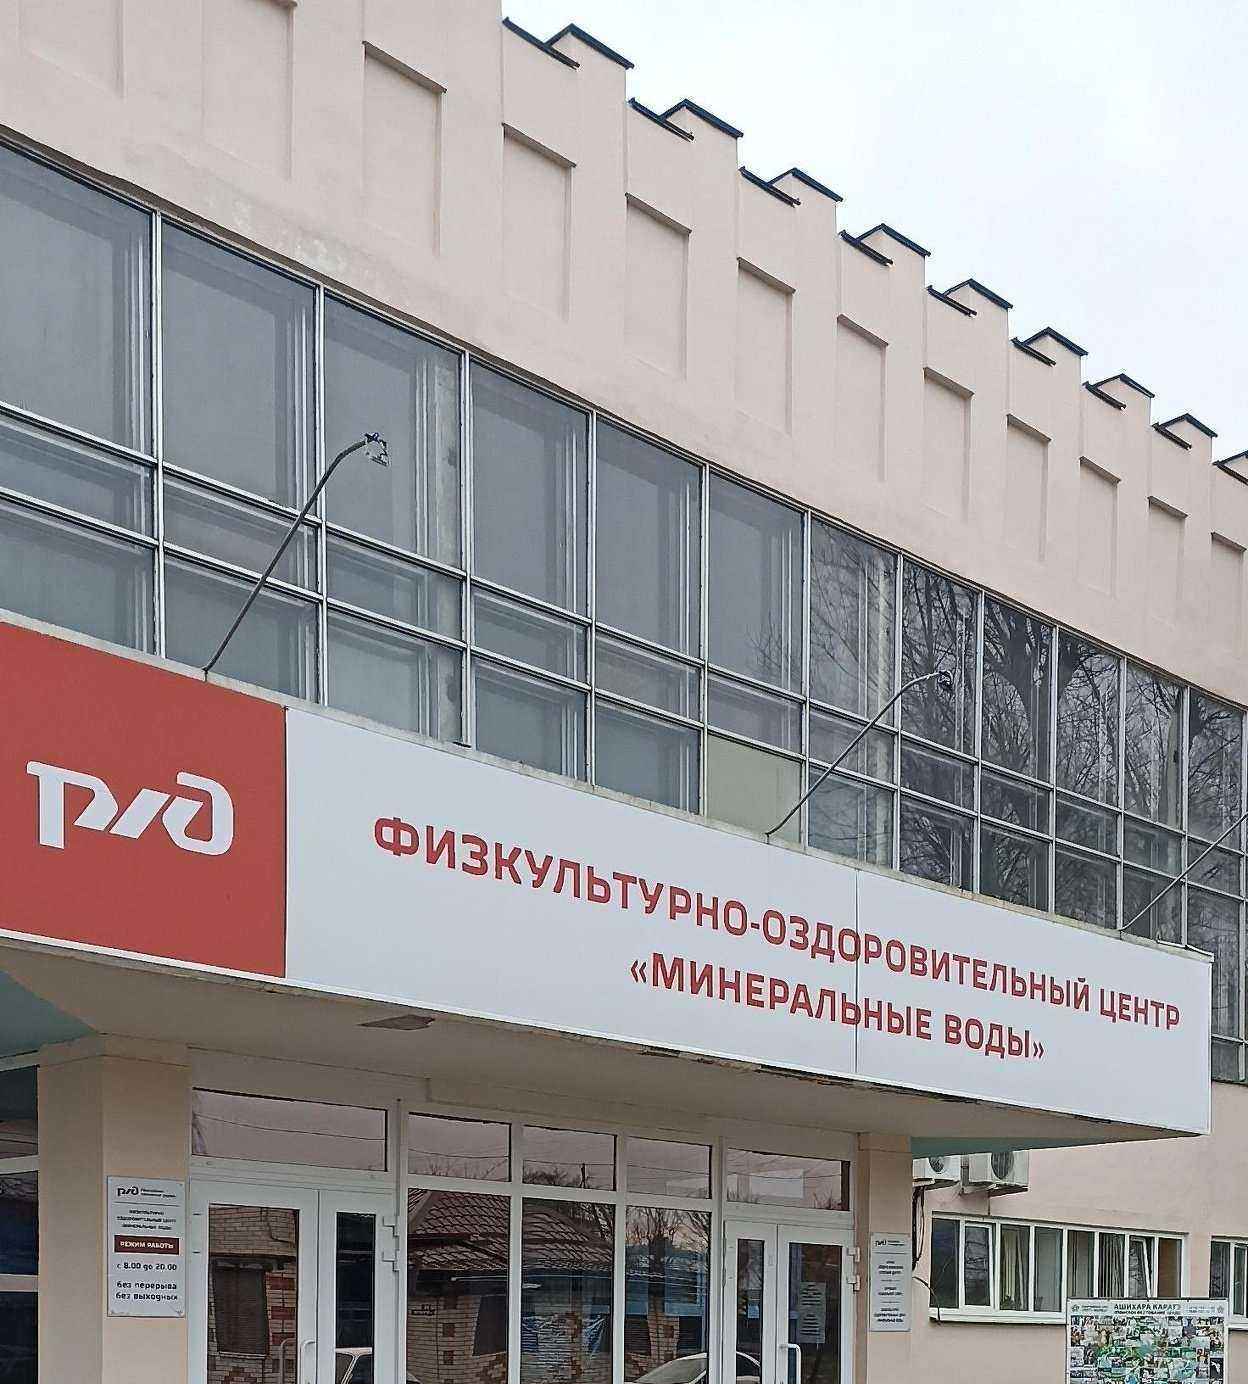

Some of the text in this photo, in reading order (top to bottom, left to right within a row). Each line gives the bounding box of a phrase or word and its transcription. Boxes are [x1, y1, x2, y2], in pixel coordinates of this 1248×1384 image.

[373, 818, 1181, 1030] ФИЗКУЛЬТУРНО-ОЗДОРОВИТЕЛЬНЫЙ ЦЕНТР
[630, 953, 1046, 1060] «МИНЕРАЛЬНЫЕ ВОДЫ»
[123, 1262, 142, 1270] 8.00
[155, 1263, 178, 1271] 20.00
[116, 1281, 177, 1291] без перерыва
[115, 1292, 178, 1302] без выходных
[1114, 1303, 1151, 1311] АШИХАРА
